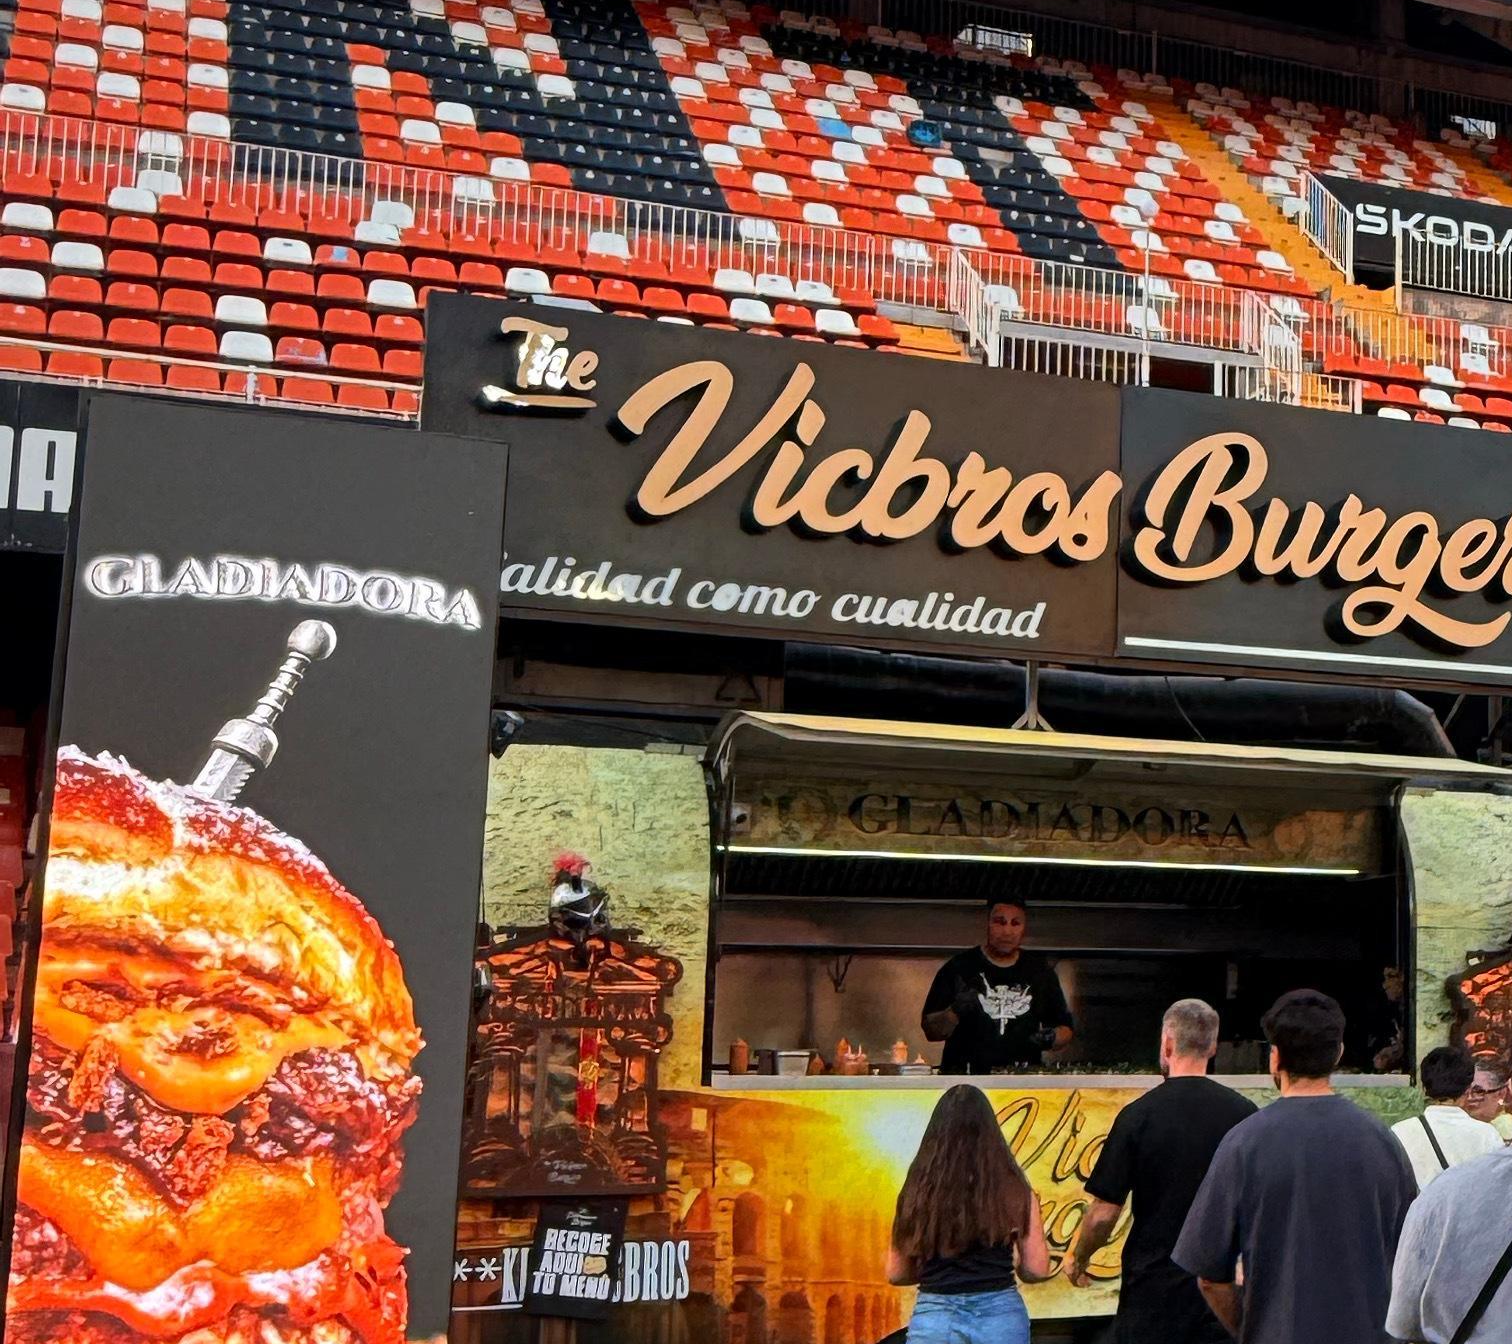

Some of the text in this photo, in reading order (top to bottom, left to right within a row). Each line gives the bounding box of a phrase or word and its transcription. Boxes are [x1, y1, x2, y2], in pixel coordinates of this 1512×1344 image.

[501, 316, 597, 391] The
[617, 360, 1122, 561] Vicbros
[86, 555, 482, 630] GLADIADORA
[500, 553, 1048, 640] alidad como cualidad
[846, 792, 1254, 849] GLADIADORA
